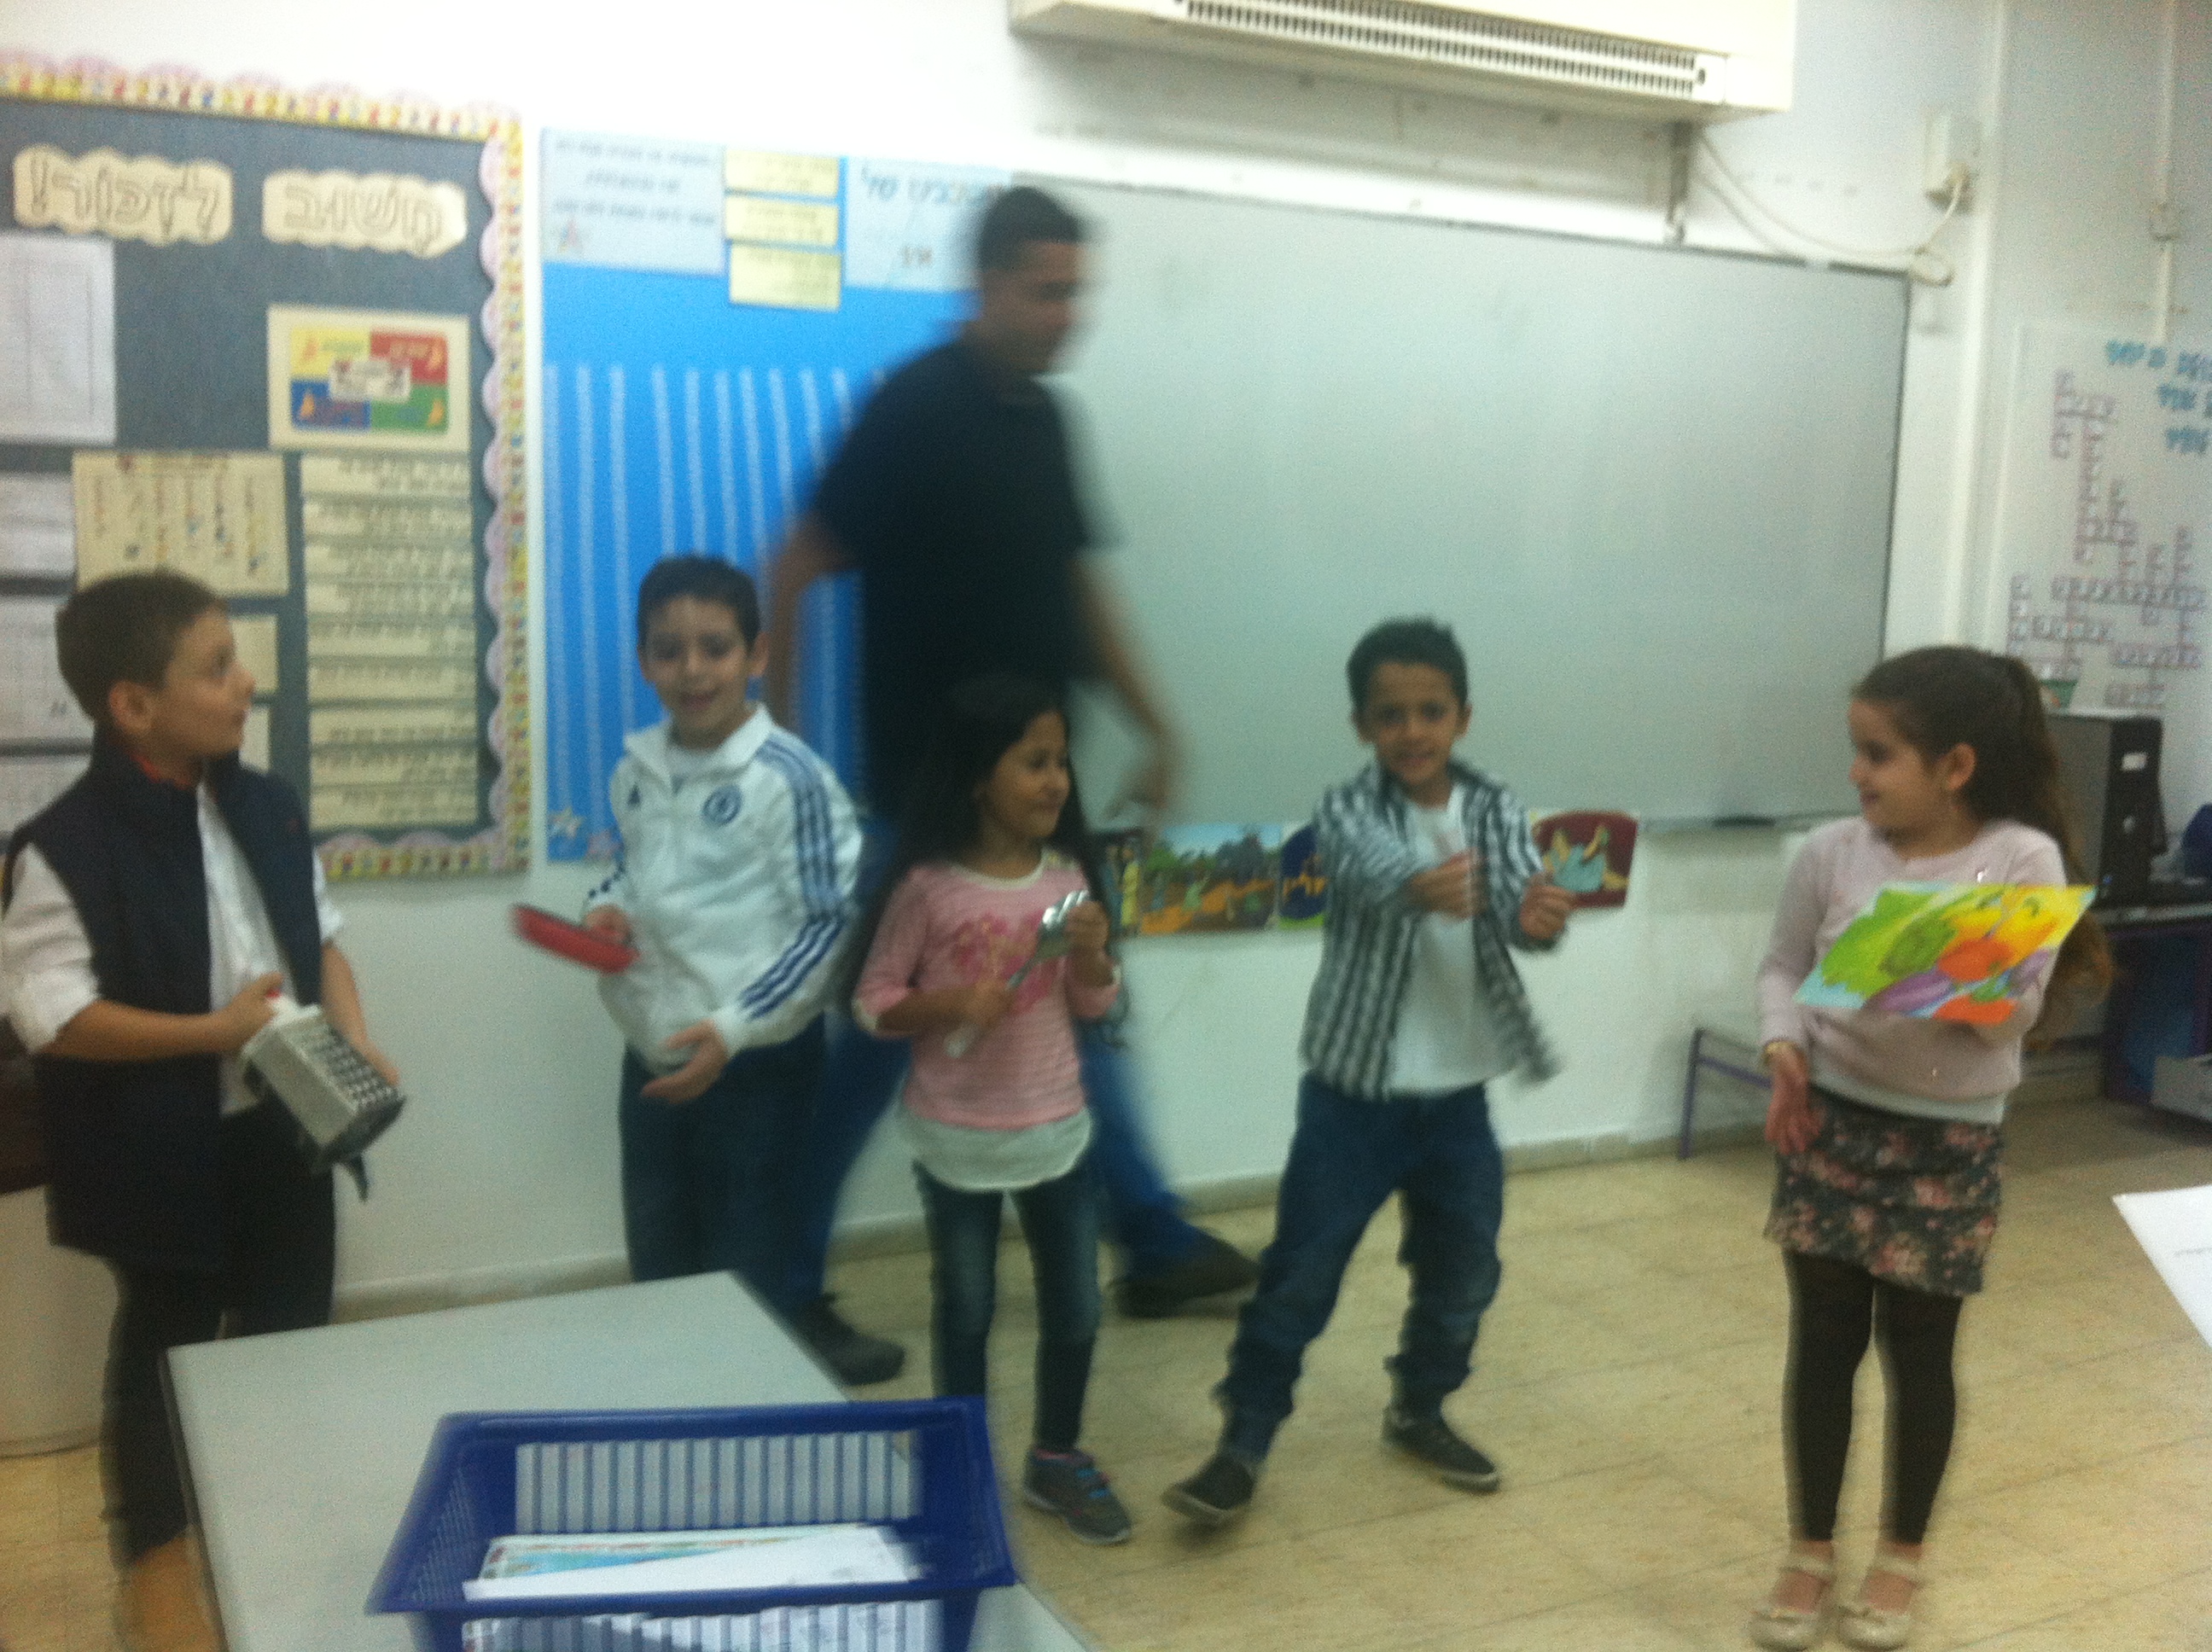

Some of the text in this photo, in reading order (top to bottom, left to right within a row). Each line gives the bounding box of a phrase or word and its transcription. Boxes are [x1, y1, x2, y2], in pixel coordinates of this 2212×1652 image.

[29, 152, 443, 254] חשוב לזכור!
[862, 164, 899, 201] של
